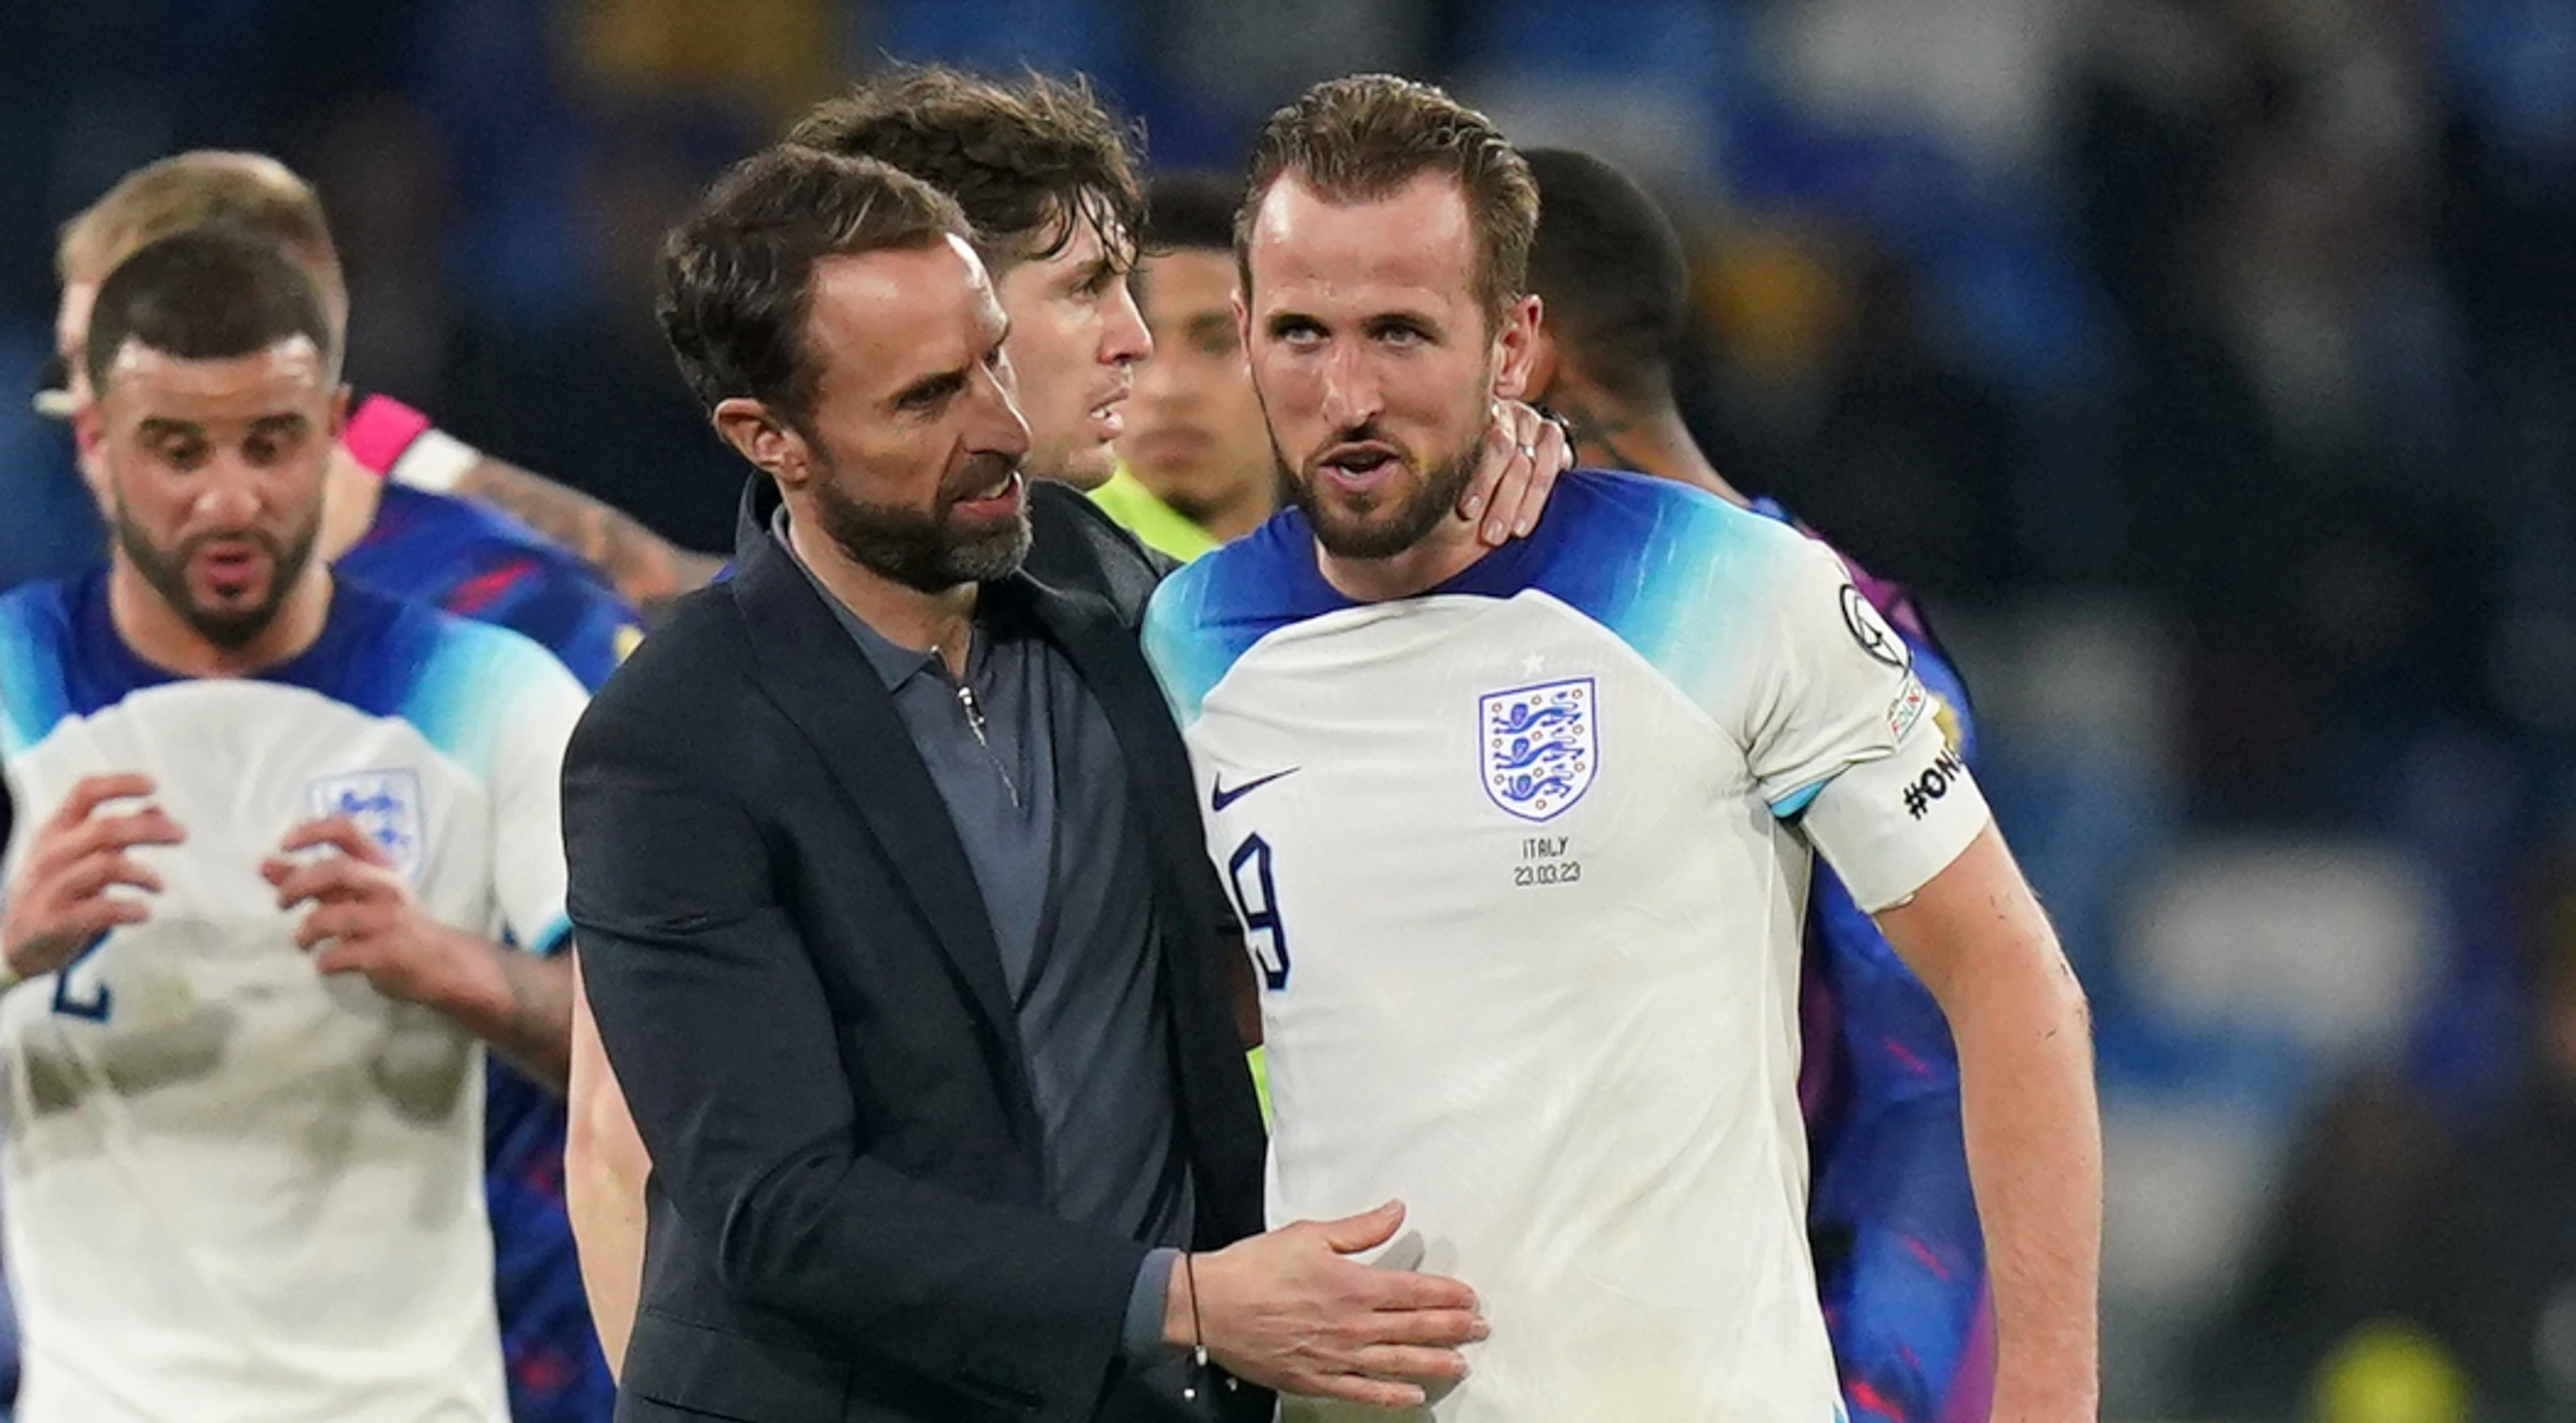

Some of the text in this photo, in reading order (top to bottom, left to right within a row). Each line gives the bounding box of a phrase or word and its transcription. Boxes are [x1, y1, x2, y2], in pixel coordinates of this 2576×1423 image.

[1523, 837, 1568, 859] ITALY
[1514, 861, 1580, 886] 23.03.23
[1229, 831, 1291, 990] 9
